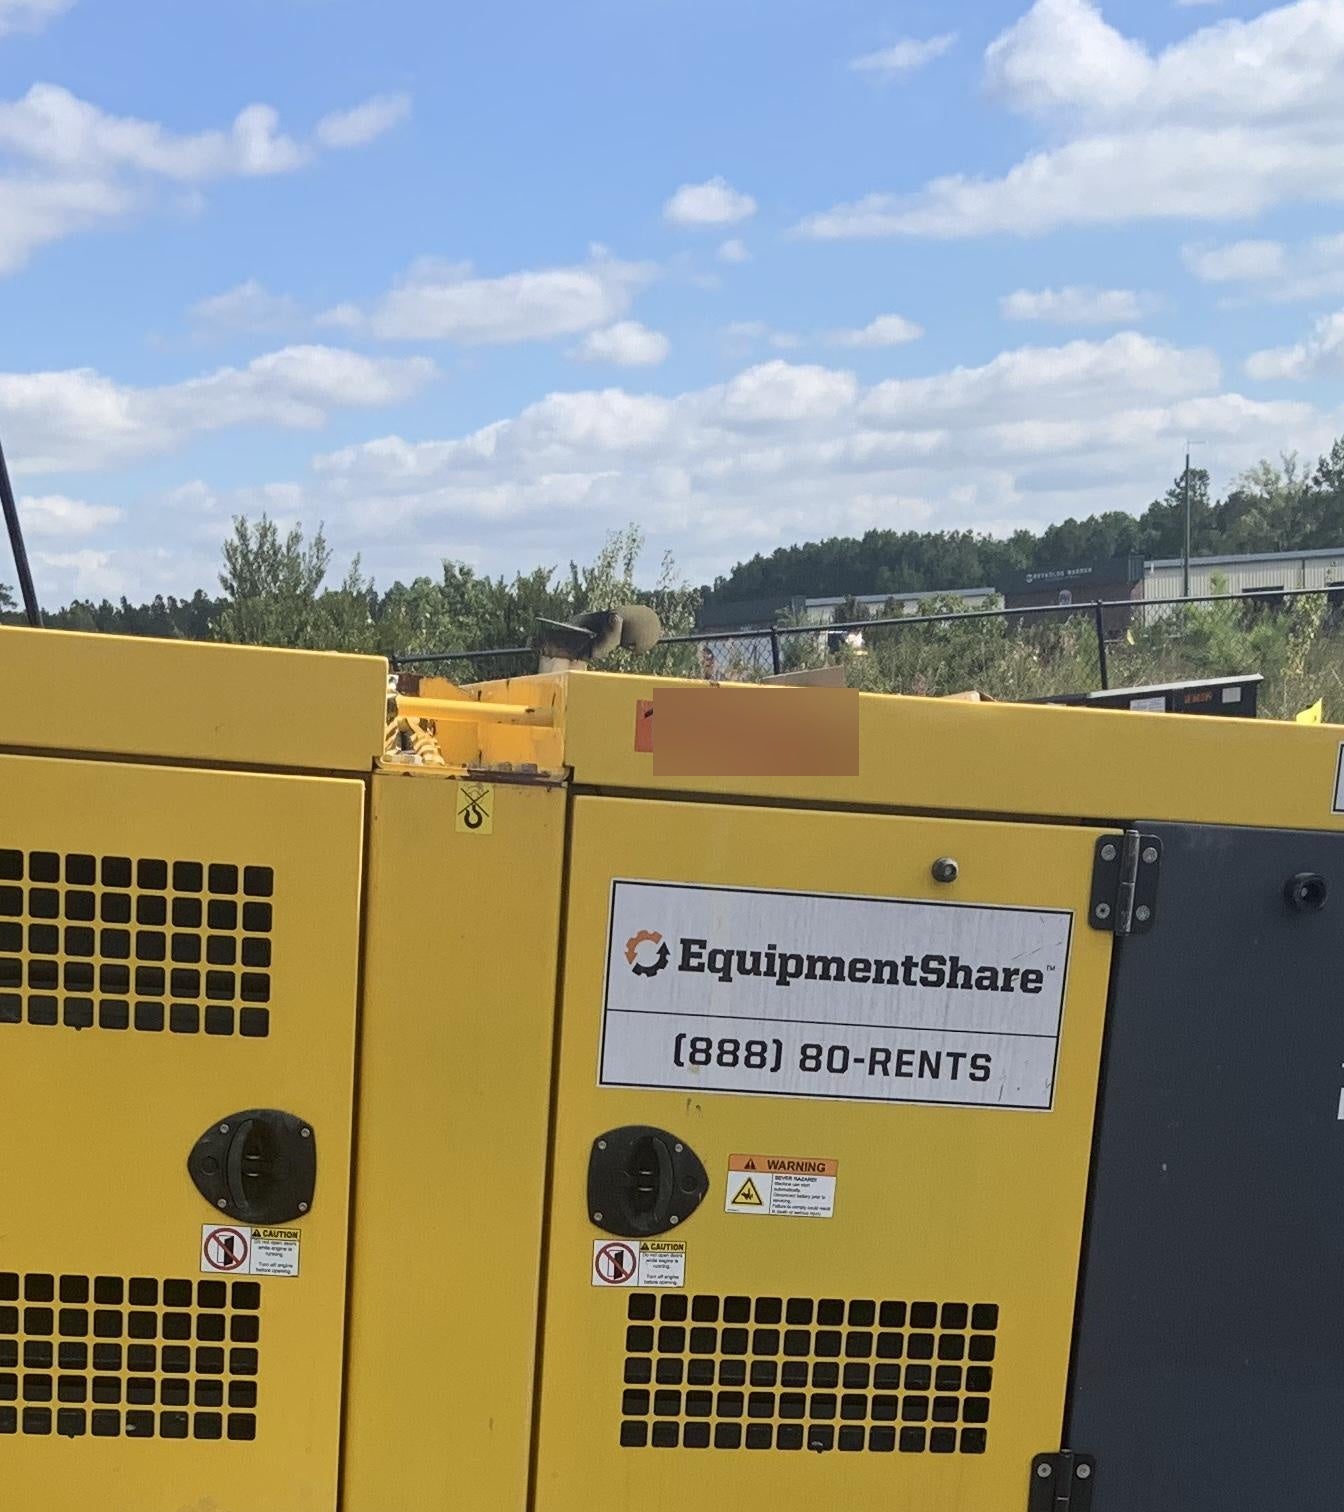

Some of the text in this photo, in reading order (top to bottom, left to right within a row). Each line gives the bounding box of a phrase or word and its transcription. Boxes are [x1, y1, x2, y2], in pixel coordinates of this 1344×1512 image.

[678, 937, 1043, 995] EquipmentShare
[674, 1033, 992, 1083] (888) 80-RENTS
[768, 1160, 826, 1172] WARNING
[263, 1230, 298, 1239] CAUTION
[651, 1243, 684, 1251] CAUTION
